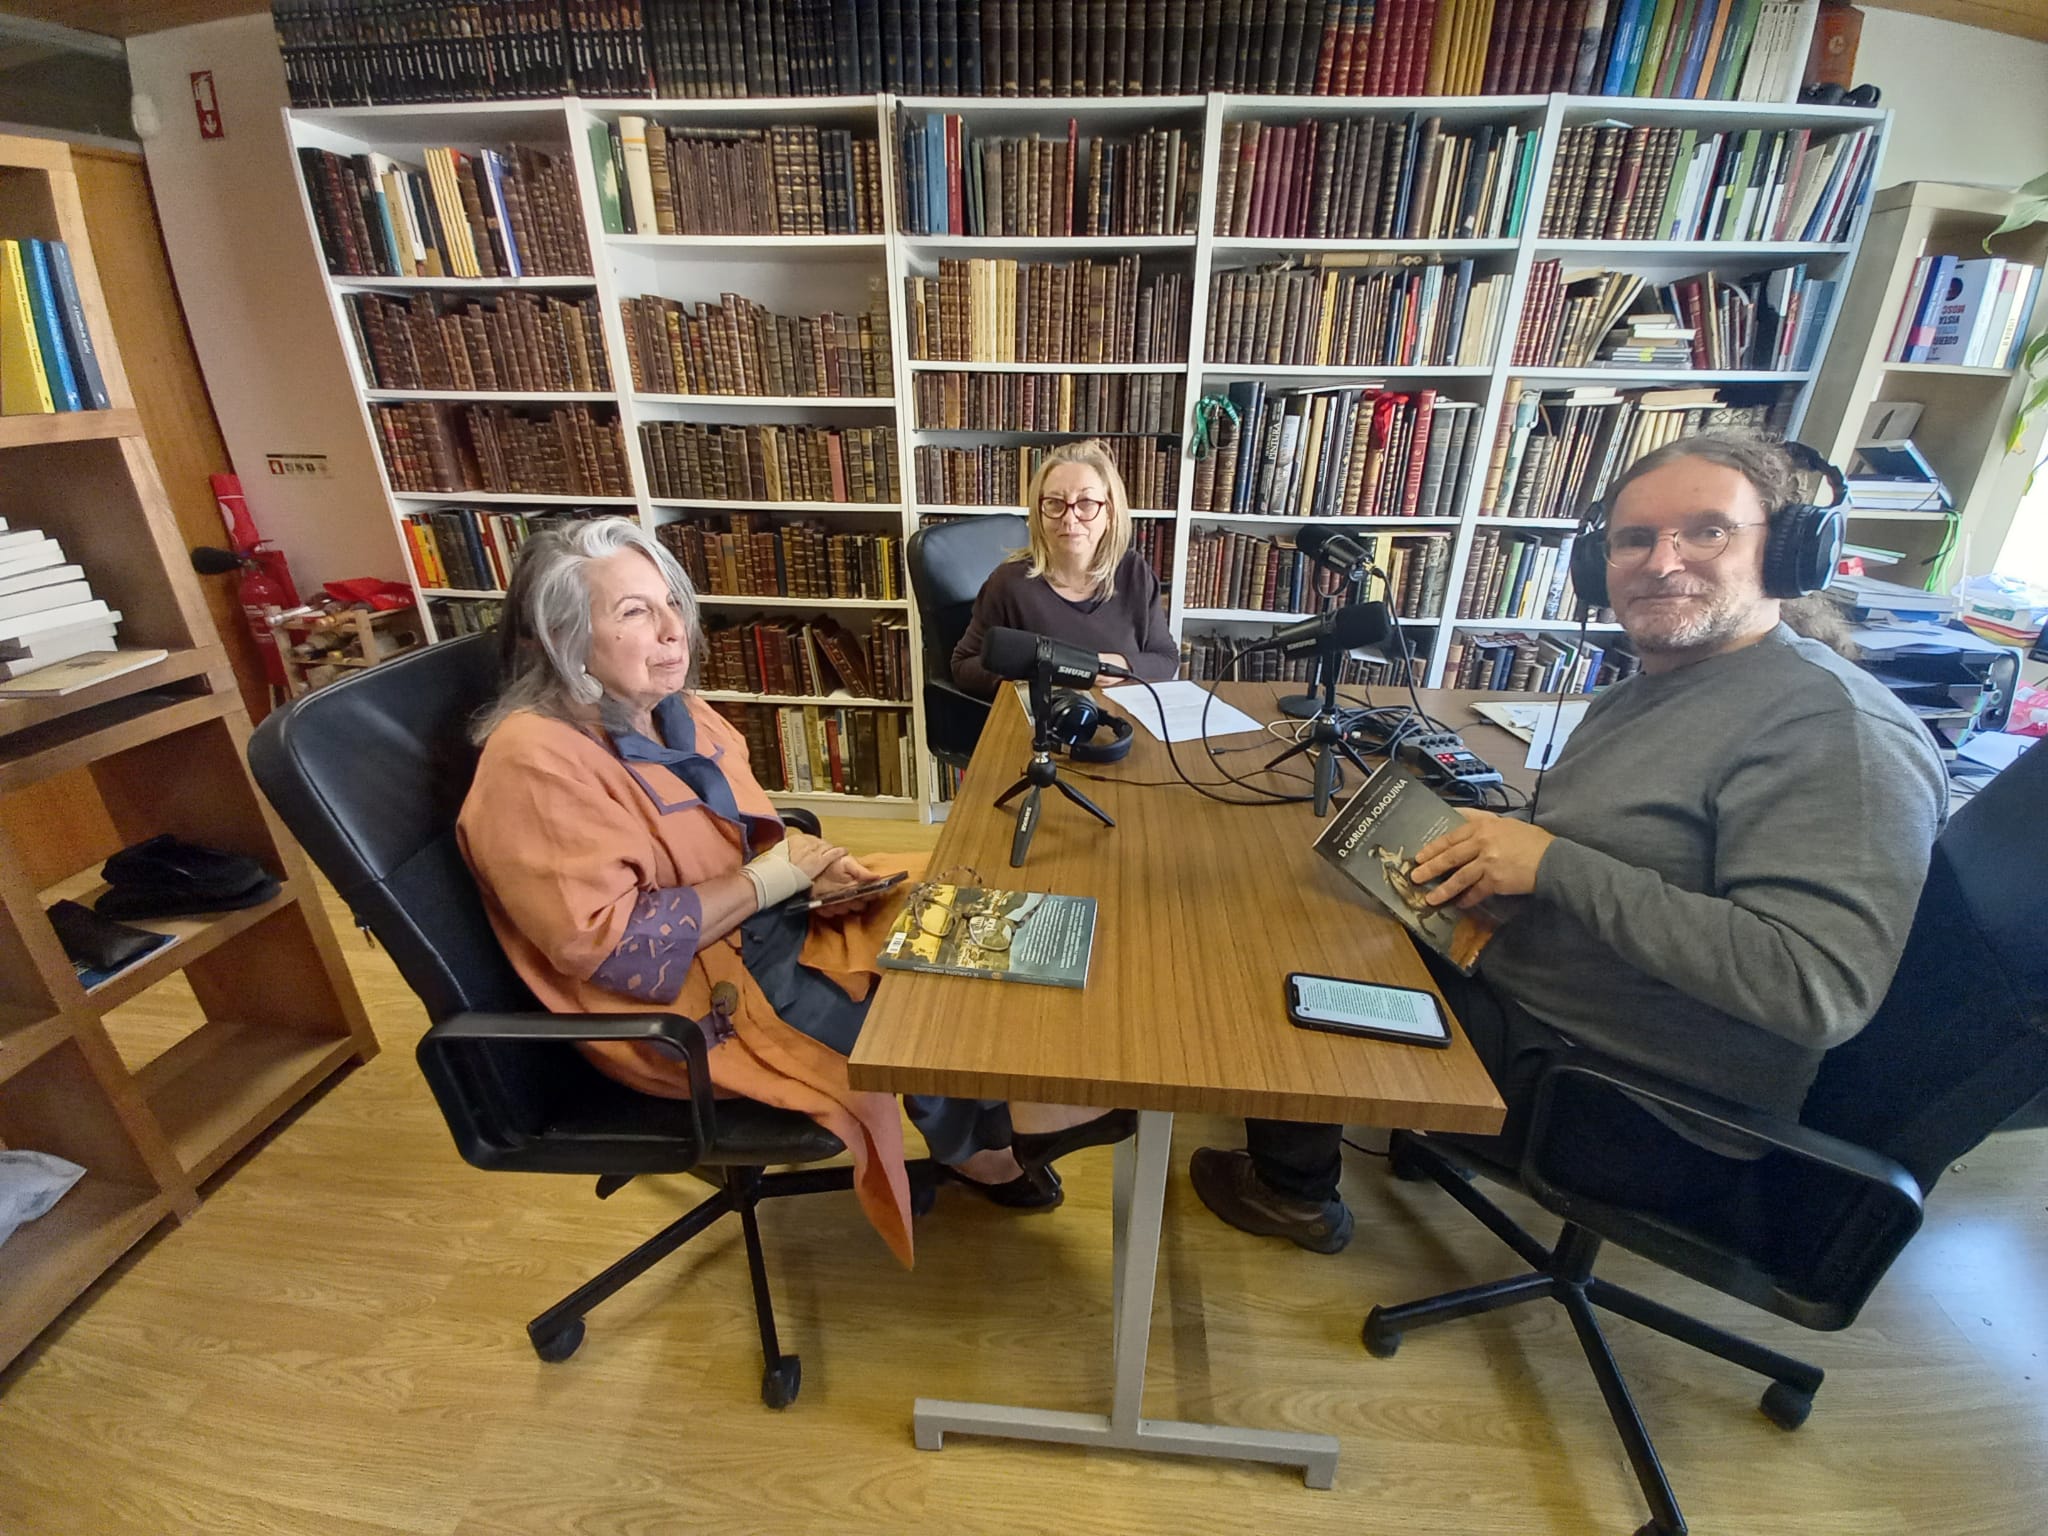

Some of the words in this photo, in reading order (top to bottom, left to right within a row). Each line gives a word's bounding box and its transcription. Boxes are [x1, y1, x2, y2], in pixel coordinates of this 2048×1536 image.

[1269, 422, 1281, 460] PINTURA
[1058, 665, 1091, 679] SHURE
[1338, 848, 1349, 857] D.
[1345, 816, 1374, 849] CARLOTA
[1371, 778, 1408, 818] JOAQUINA
